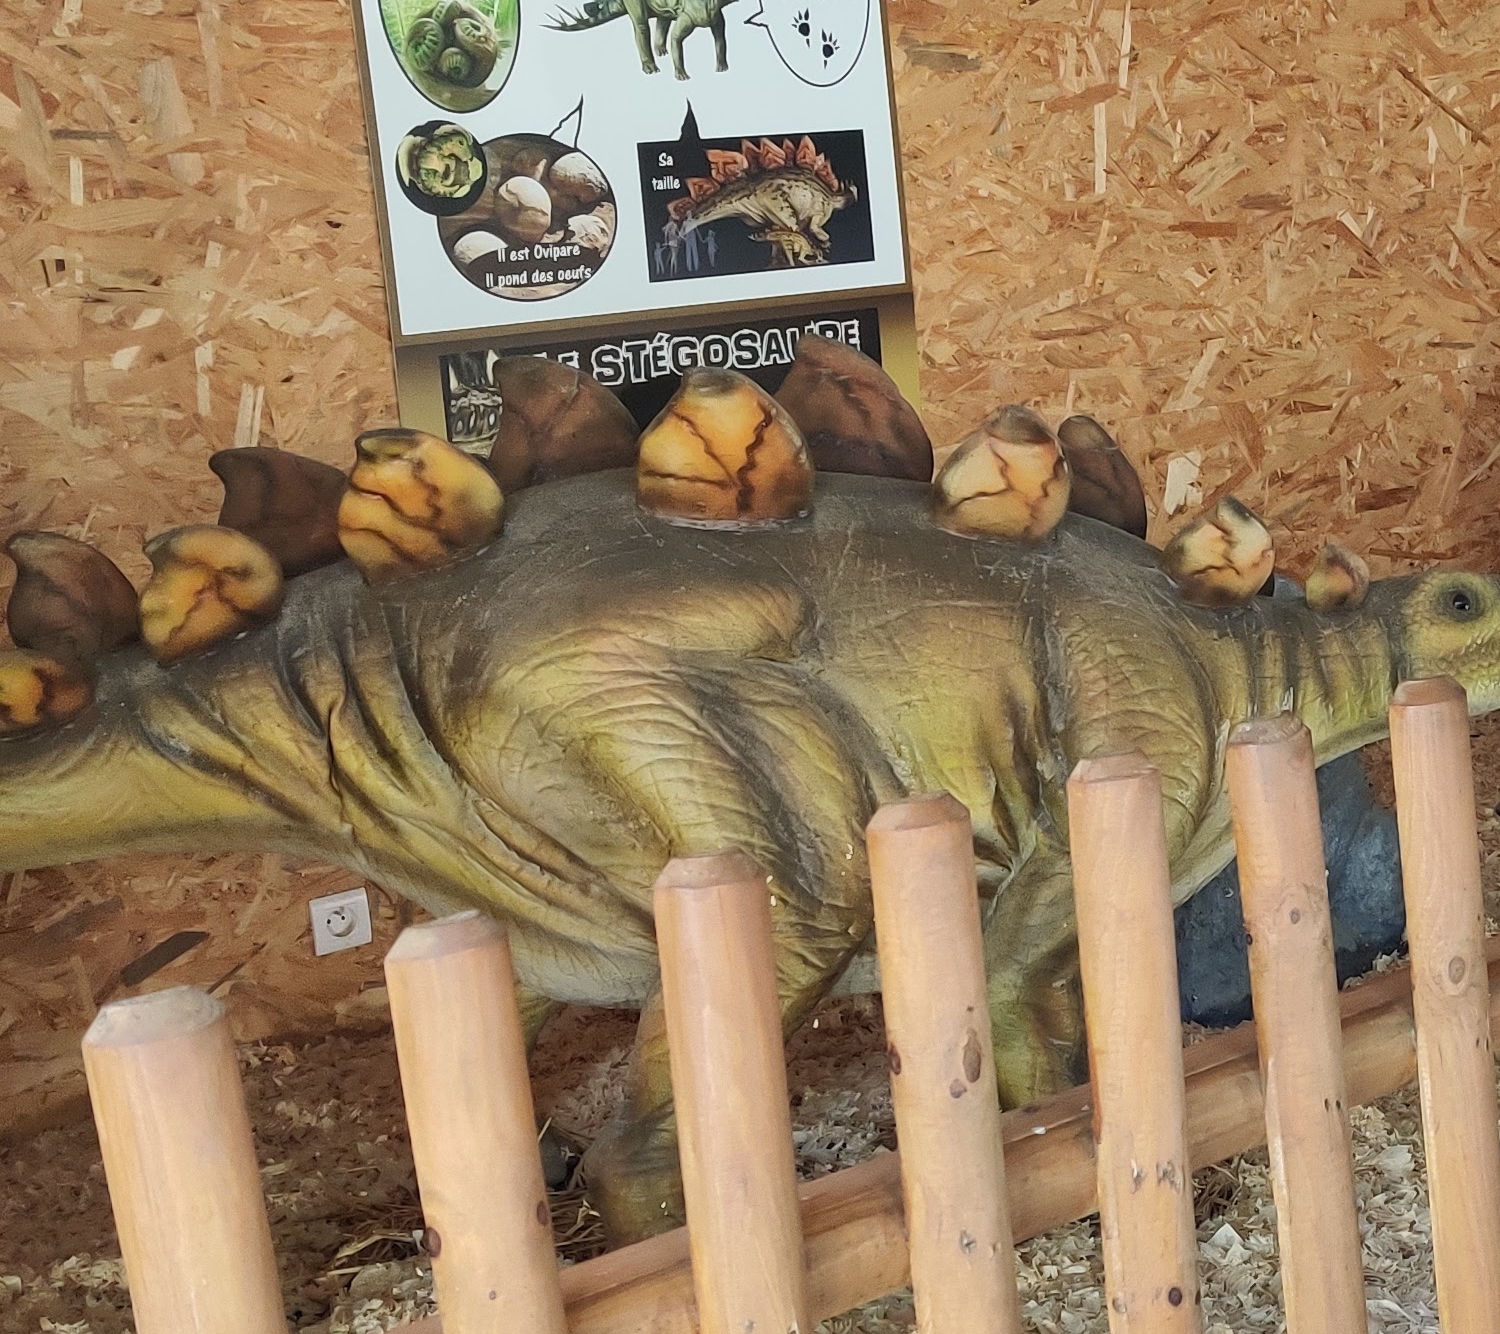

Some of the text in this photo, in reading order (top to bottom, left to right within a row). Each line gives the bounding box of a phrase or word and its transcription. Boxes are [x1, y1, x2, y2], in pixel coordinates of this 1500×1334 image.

[658, 151, 674, 167] Sa
[651, 175, 681, 192] taille
[497, 243, 581, 262] Il est Ovipare
[485, 264, 592, 288] Il pond des oeufs
